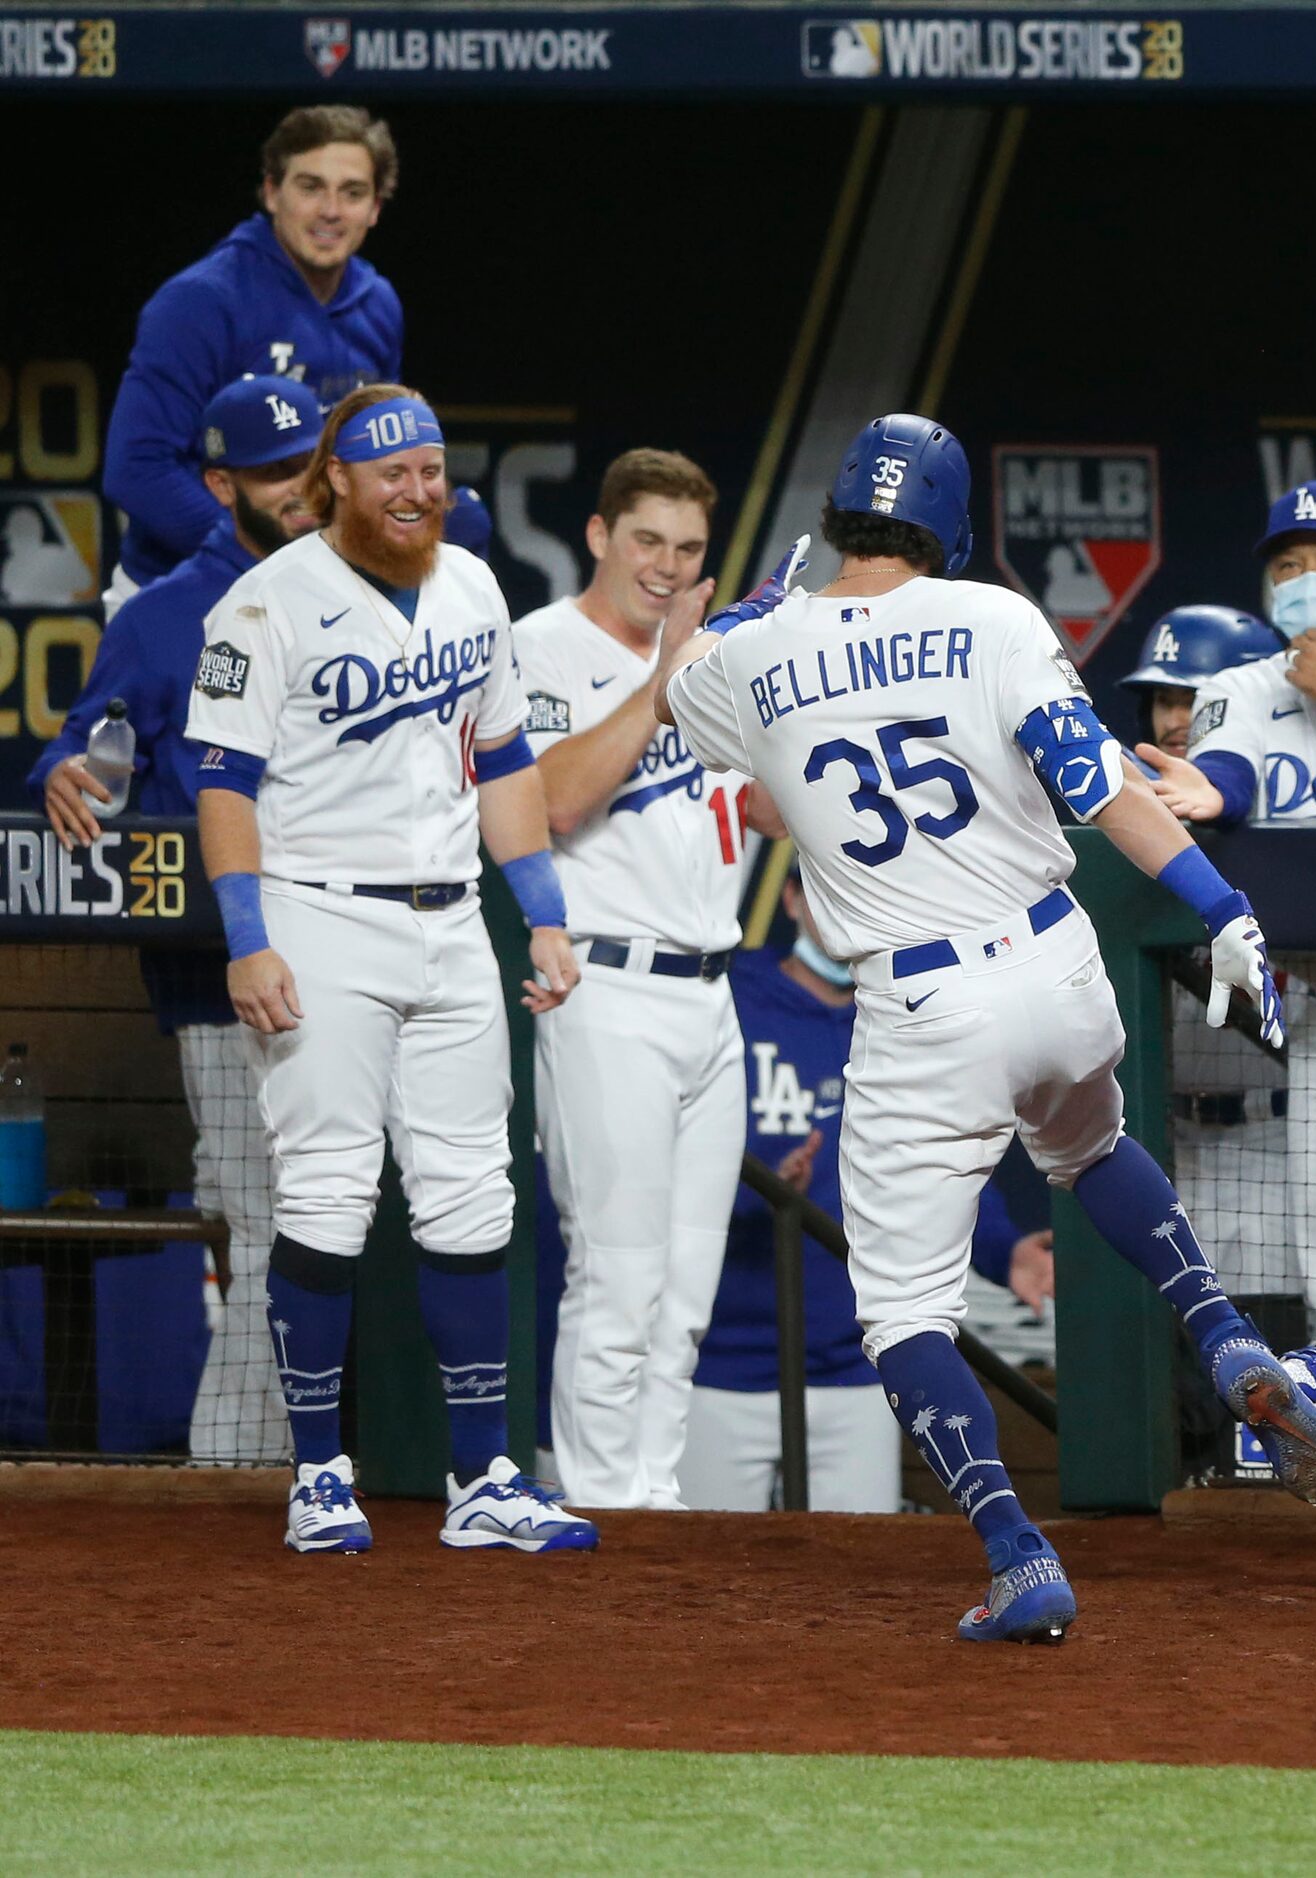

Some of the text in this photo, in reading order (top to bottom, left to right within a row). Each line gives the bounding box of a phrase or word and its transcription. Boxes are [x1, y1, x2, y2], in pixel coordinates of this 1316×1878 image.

[0, 20, 77, 77] RIES
[79, 19, 116, 48] 20
[355, 30, 612, 70] MLB NETWORK
[884, 20, 1142, 78] WORLD SERIES
[1144, 20, 1183, 49] 20
[79, 48, 116, 77] 20
[1144, 50, 1183, 79] 20
[0, 359, 98, 481] 0
[265, 395, 302, 430] LA
[366, 412, 402, 450] 10
[872, 456, 907, 488] 35
[1006, 460, 1147, 518] MLB
[1153, 624, 1180, 662] LA
[199, 668, 242, 693] SERIES
[201, 651, 247, 677] WORLD
[750, 628, 973, 729] BELLINGER
[523, 715, 568, 732] ERIES
[529, 699, 568, 717] ORLD
[1067, 716, 1089, 738] LA
[804, 715, 980, 868] 35
[130, 832, 185, 874] 20
[0, 829, 124, 917] RIES
[130, 876, 185, 918] 20
[752, 1041, 815, 1135] LA
